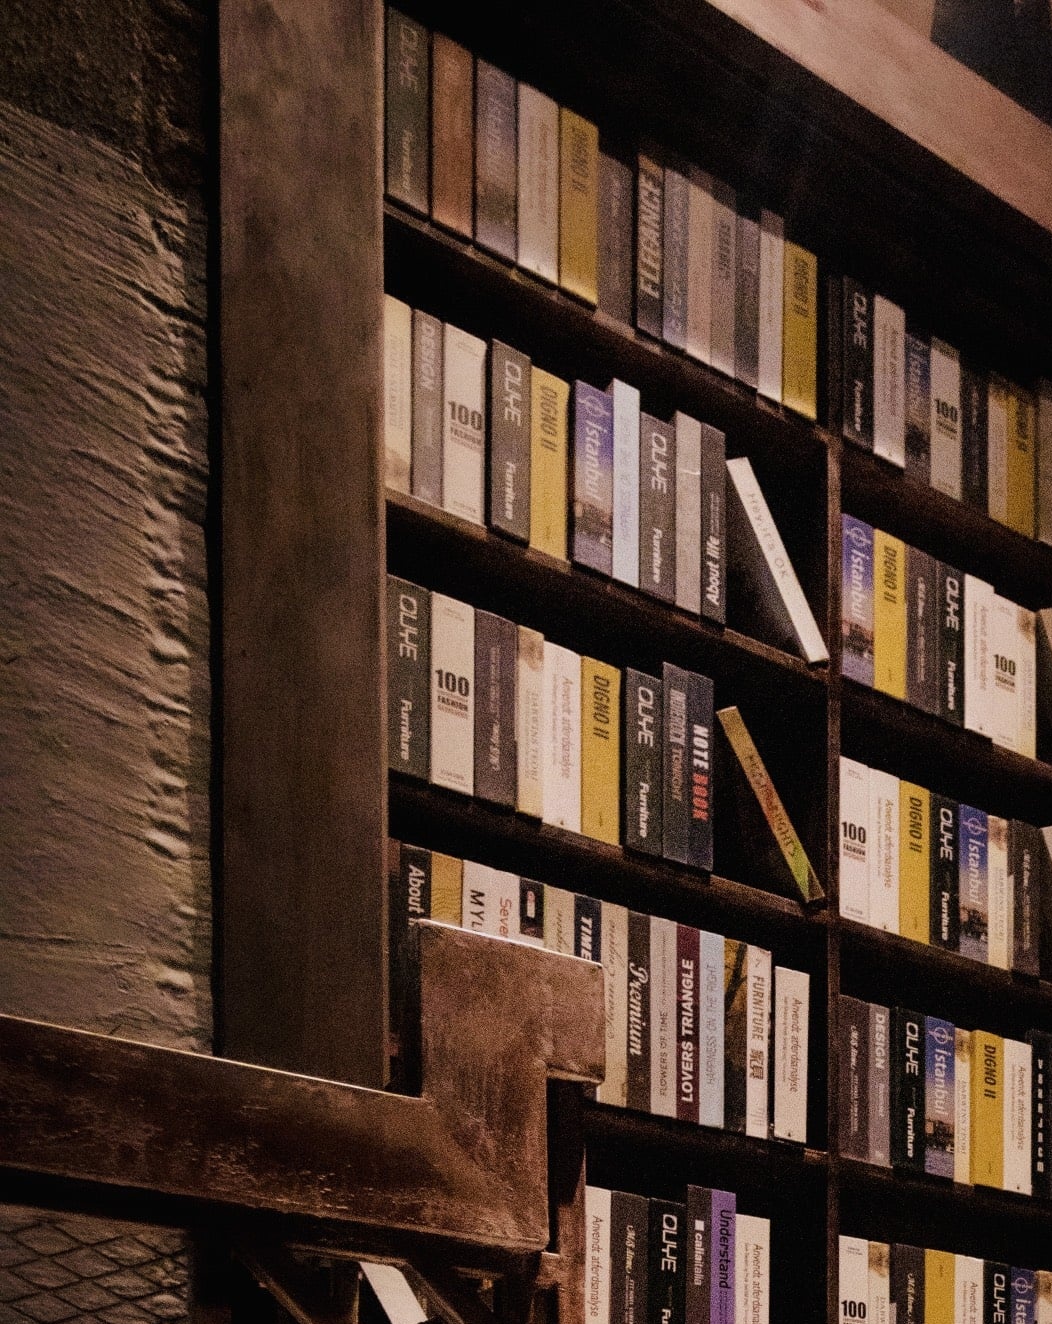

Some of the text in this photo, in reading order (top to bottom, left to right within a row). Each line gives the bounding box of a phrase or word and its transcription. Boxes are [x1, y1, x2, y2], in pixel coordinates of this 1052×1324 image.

[639, 167, 663, 299] ELEGANCE
[421, 322, 436, 393] DESIGN
[448, 400, 483, 432] 100
[539, 385, 558, 453] DIGNO II
[935, 399, 959, 422] 100
[505, 460, 516, 521] Furniture
[652, 528, 664, 584] Furniture
[706, 534, 720, 561] life
[705, 559, 720, 607] About
[883, 545, 897, 605] DIGNO II
[434, 668, 469, 698] 100
[993, 653, 1017, 677] 100
[400, 699, 412, 760] Furniture
[437, 694, 469, 712] FASHION
[592, 674, 610, 741] DIGNO II
[692, 723, 709, 822] NOTE BOOK
[639, 781, 650, 838] Furniture
[841, 821, 867, 844] 100
[909, 796, 922, 854] DIGNO II
[408, 864, 425, 917] About
[941, 891, 951, 941] Furniture
[629, 962, 649, 1055] Premium
[661, 1011, 669, 1029] TIME
[681, 958, 694, 1103] LOVERS TRIANGLE
[706, 963, 718, 1086] HAPPINESS ON THE RIGHT
[753, 975, 766, 1046] FURNITURE
[791, 995, 803, 1034] Anvendt
[660, 1031, 669, 1045] OF
[874, 1013, 886, 1070] DESIGN
[659, 1045, 669, 1098] FLOWERS
[983, 1043, 997, 1100] DIGNO II
[906, 1107, 916, 1159] Furniture
[591, 1215, 603, 1253] Anvendt
[718, 1209, 732, 1289] Understand
[752, 1243, 764, 1277] Anvendt
[841, 1300, 867, 1319] 100
